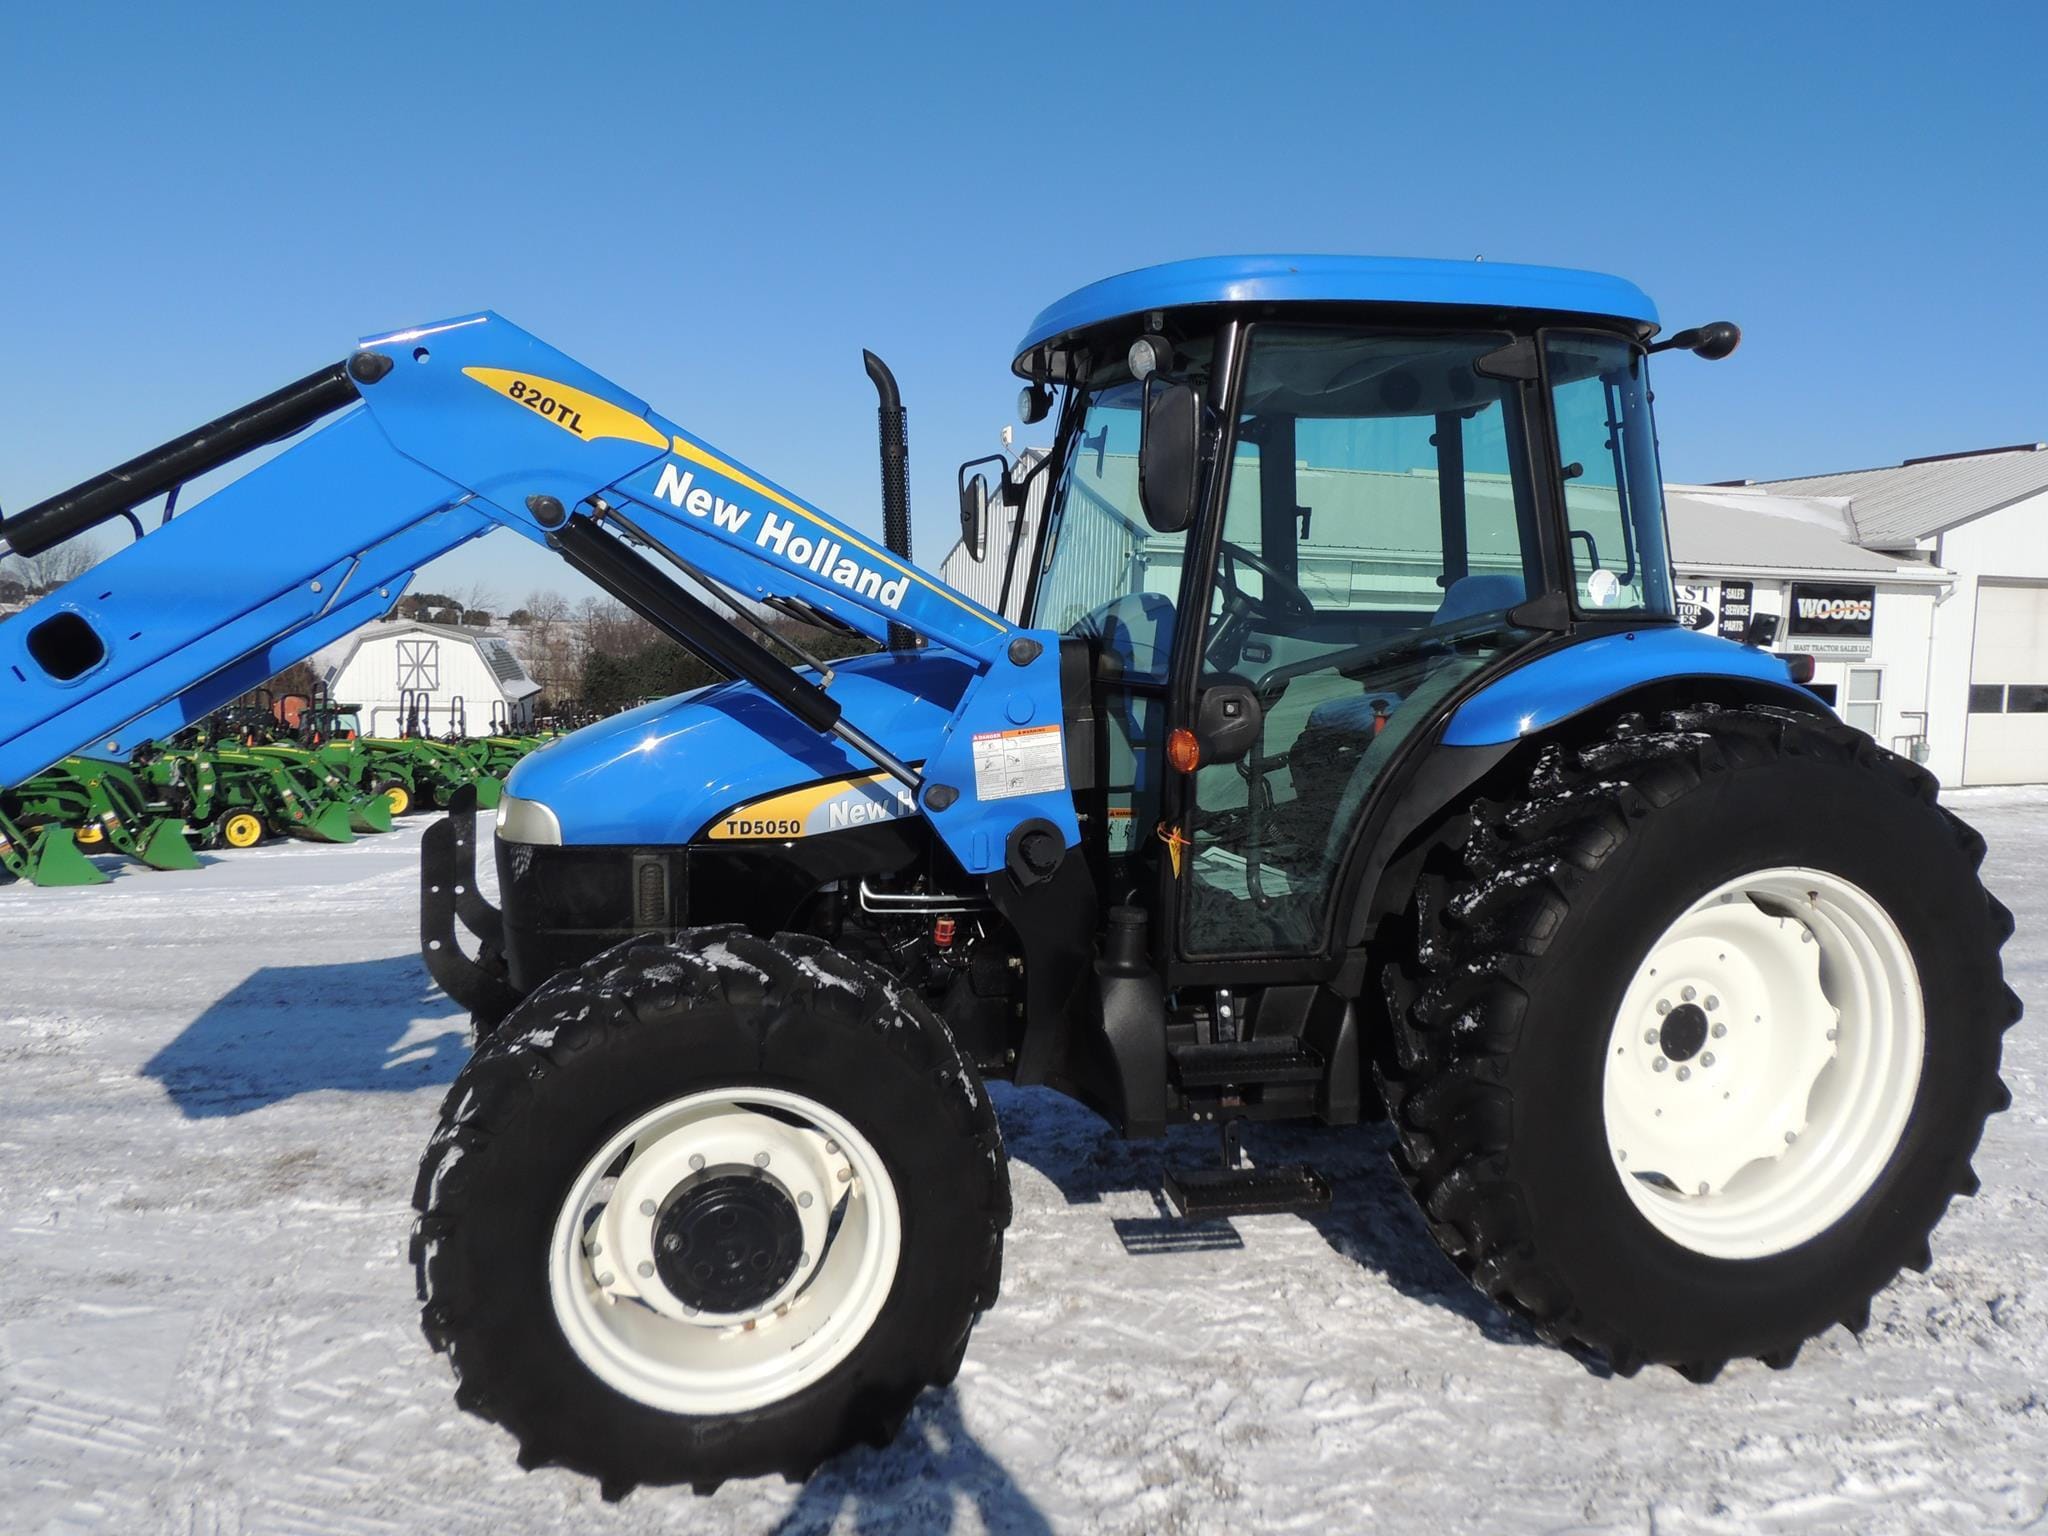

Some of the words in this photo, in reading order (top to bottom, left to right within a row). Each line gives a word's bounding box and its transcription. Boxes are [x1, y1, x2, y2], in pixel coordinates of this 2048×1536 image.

[508, 379, 583, 434] 820TL
[653, 463, 751, 535] New
[755, 512, 910, 611] Holland
[1726, 588, 1745, 600] SALES
[1677, 604, 1702, 616] TOR
[1725, 604, 1750, 616] SERVICE
[1797, 598, 1872, 621] WOODS
[1679, 615, 1698, 625] ES
[1723, 620, 1744, 632] PARTS
[1793, 644, 1811, 652] MAST
[1858, 645, 1871, 653] LLC
[829, 800, 889, 829] New
[897, 789, 918, 816] H
[726, 819, 801, 836] TD5050
